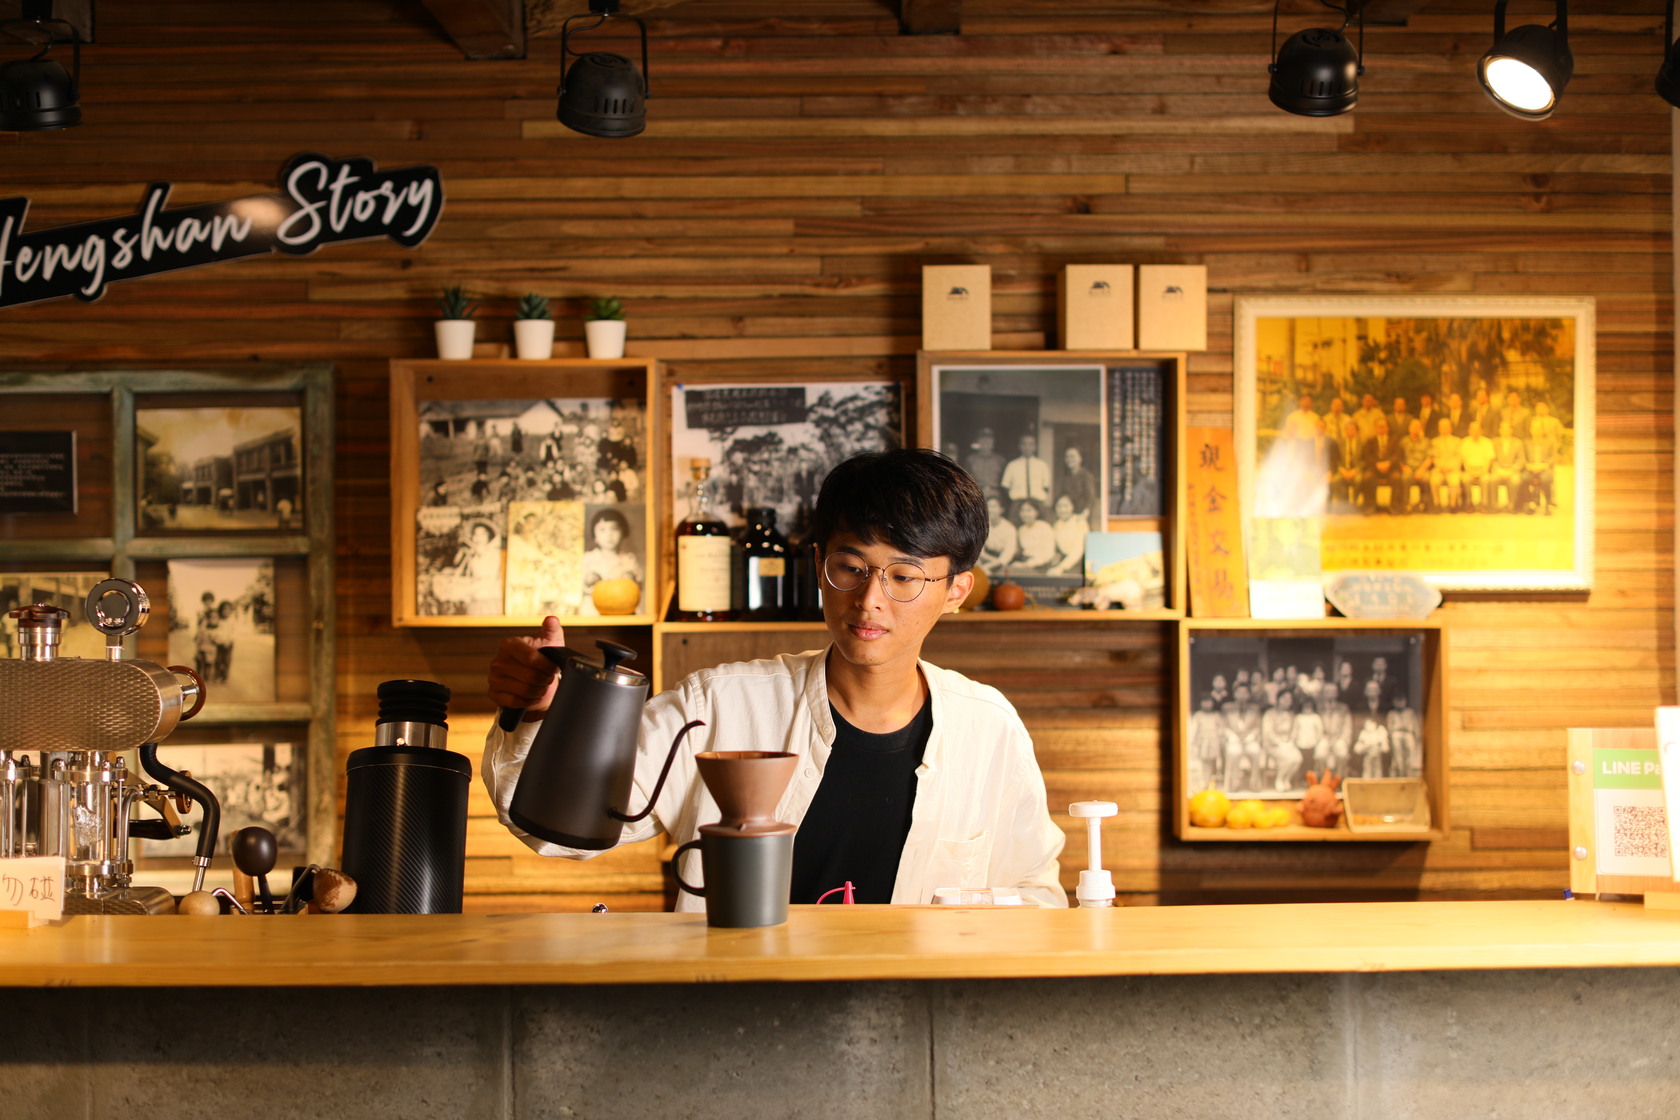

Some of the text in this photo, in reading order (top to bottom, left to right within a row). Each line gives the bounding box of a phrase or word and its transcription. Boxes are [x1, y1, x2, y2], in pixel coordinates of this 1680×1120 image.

[277, 160, 435, 246] Story
[1602, 761, 1641, 775] LINE
[2, 873, 56, 907] 勿碰
